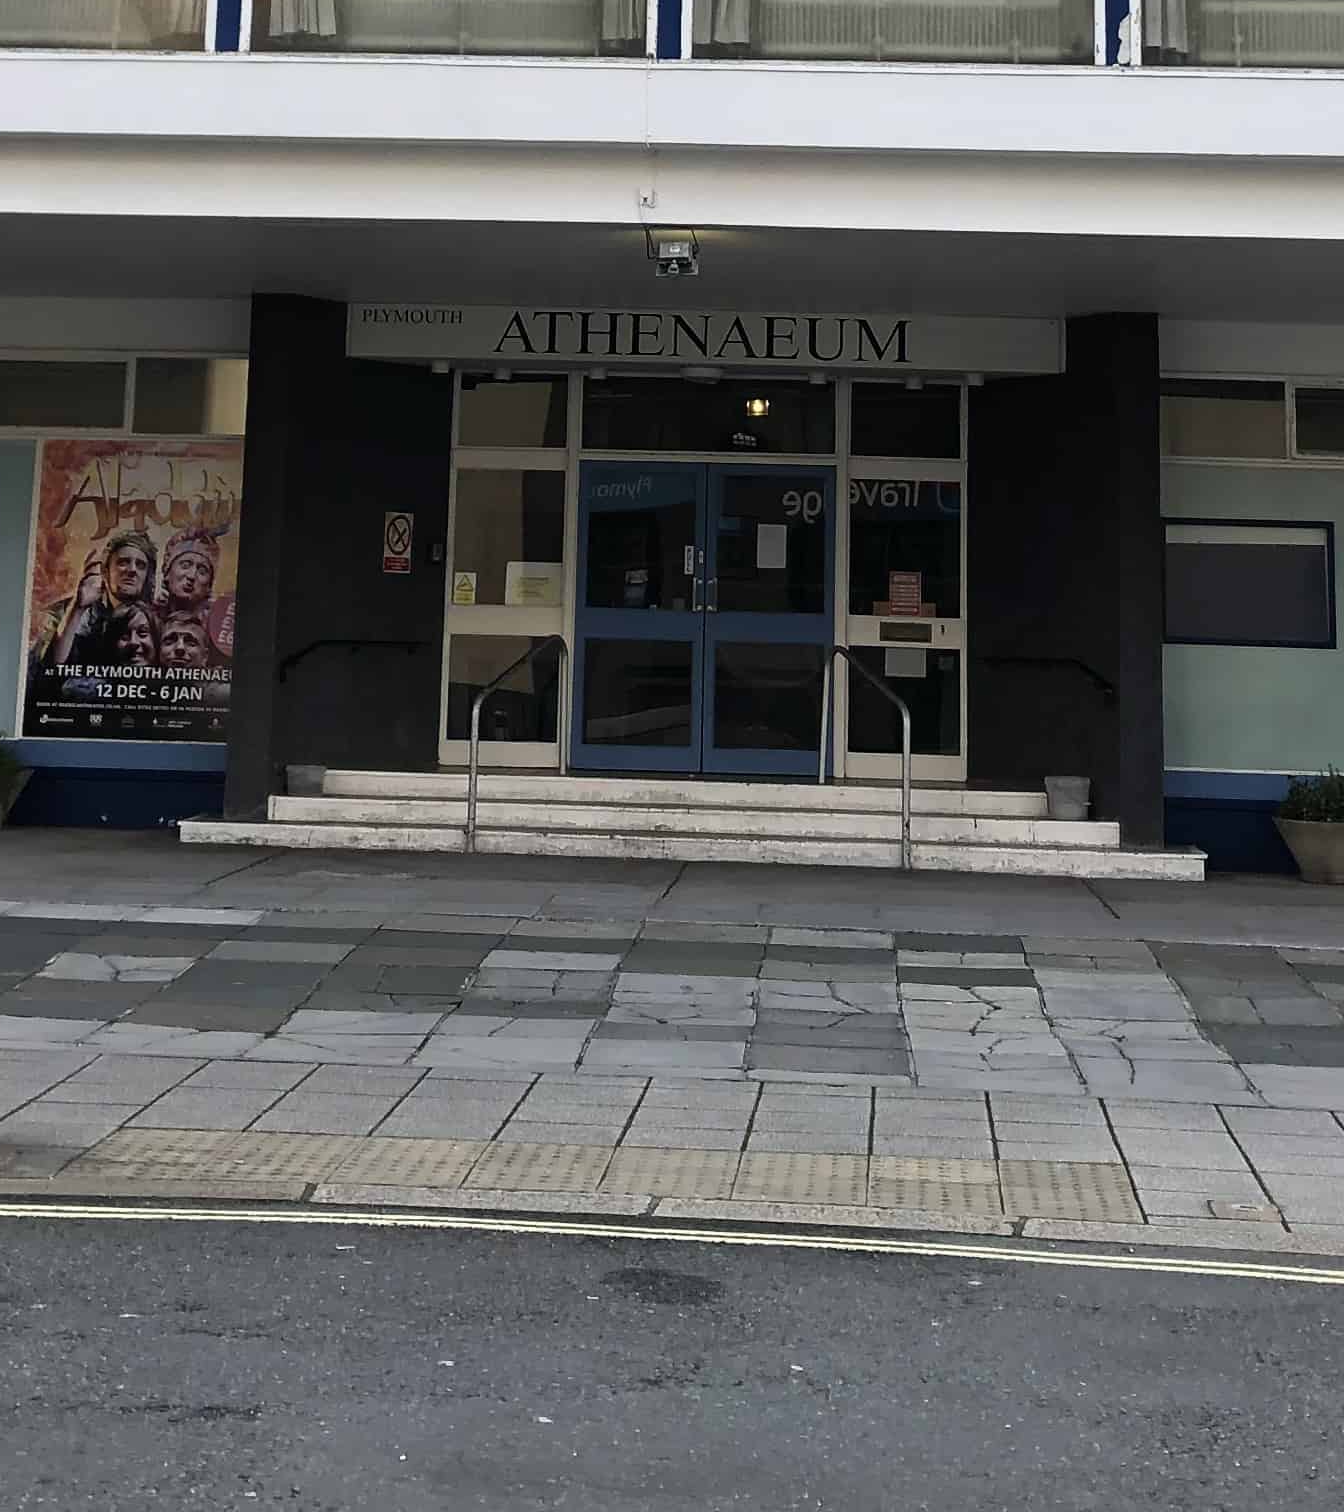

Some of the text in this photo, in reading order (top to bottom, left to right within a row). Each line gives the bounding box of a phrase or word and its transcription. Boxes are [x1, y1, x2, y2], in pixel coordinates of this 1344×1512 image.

[361, 307, 912, 364] PLYMOUTH ATHENAEUM
[56, 664, 83, 677] THE
[86, 666, 162, 679] PLYMOUTH
[96, 684, 112, 698] 12
[117, 685, 147, 700] DEC
[160, 685, 169, 699] 6
[170, 686, 203, 702] JAN
